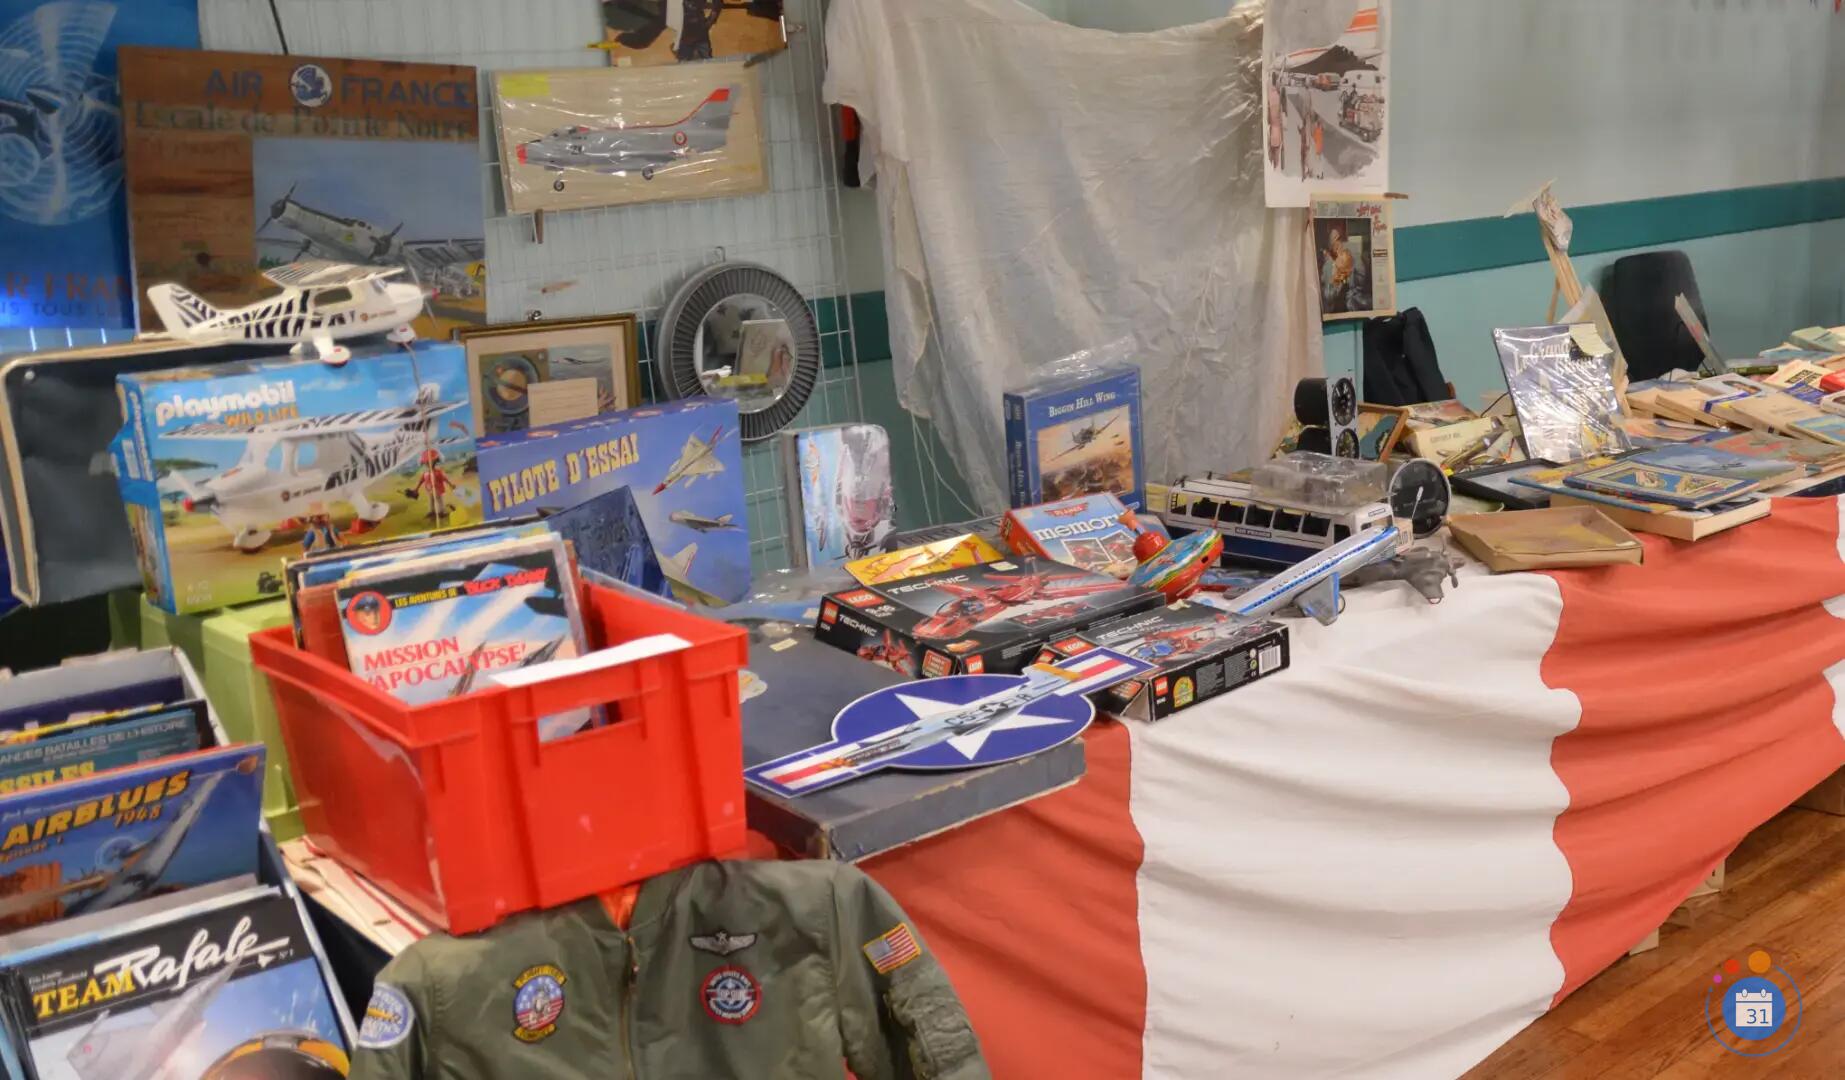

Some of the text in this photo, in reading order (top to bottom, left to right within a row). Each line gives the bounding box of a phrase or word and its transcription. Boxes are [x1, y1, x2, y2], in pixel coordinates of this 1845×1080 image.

[205, 69, 474, 108] AIR FRANCE
[156, 379, 297, 428] playmobil
[224, 404, 299, 428] WILD LIFE
[487, 432, 640, 513] PILOTE D'ESSAI
[1034, 514, 1119, 542] memor
[886, 574, 970, 596] TECHNIC
[838, 613, 878, 638] TECHNIC
[1095, 615, 1164, 641] TECHNIC
[363, 636, 460, 672] MISSION
[2, 770, 191, 850] AIRBLUES
[114, 804, 162, 829] 1948
[94, 915, 290, 992] Rafale
[33, 968, 138, 1020] TEAM
